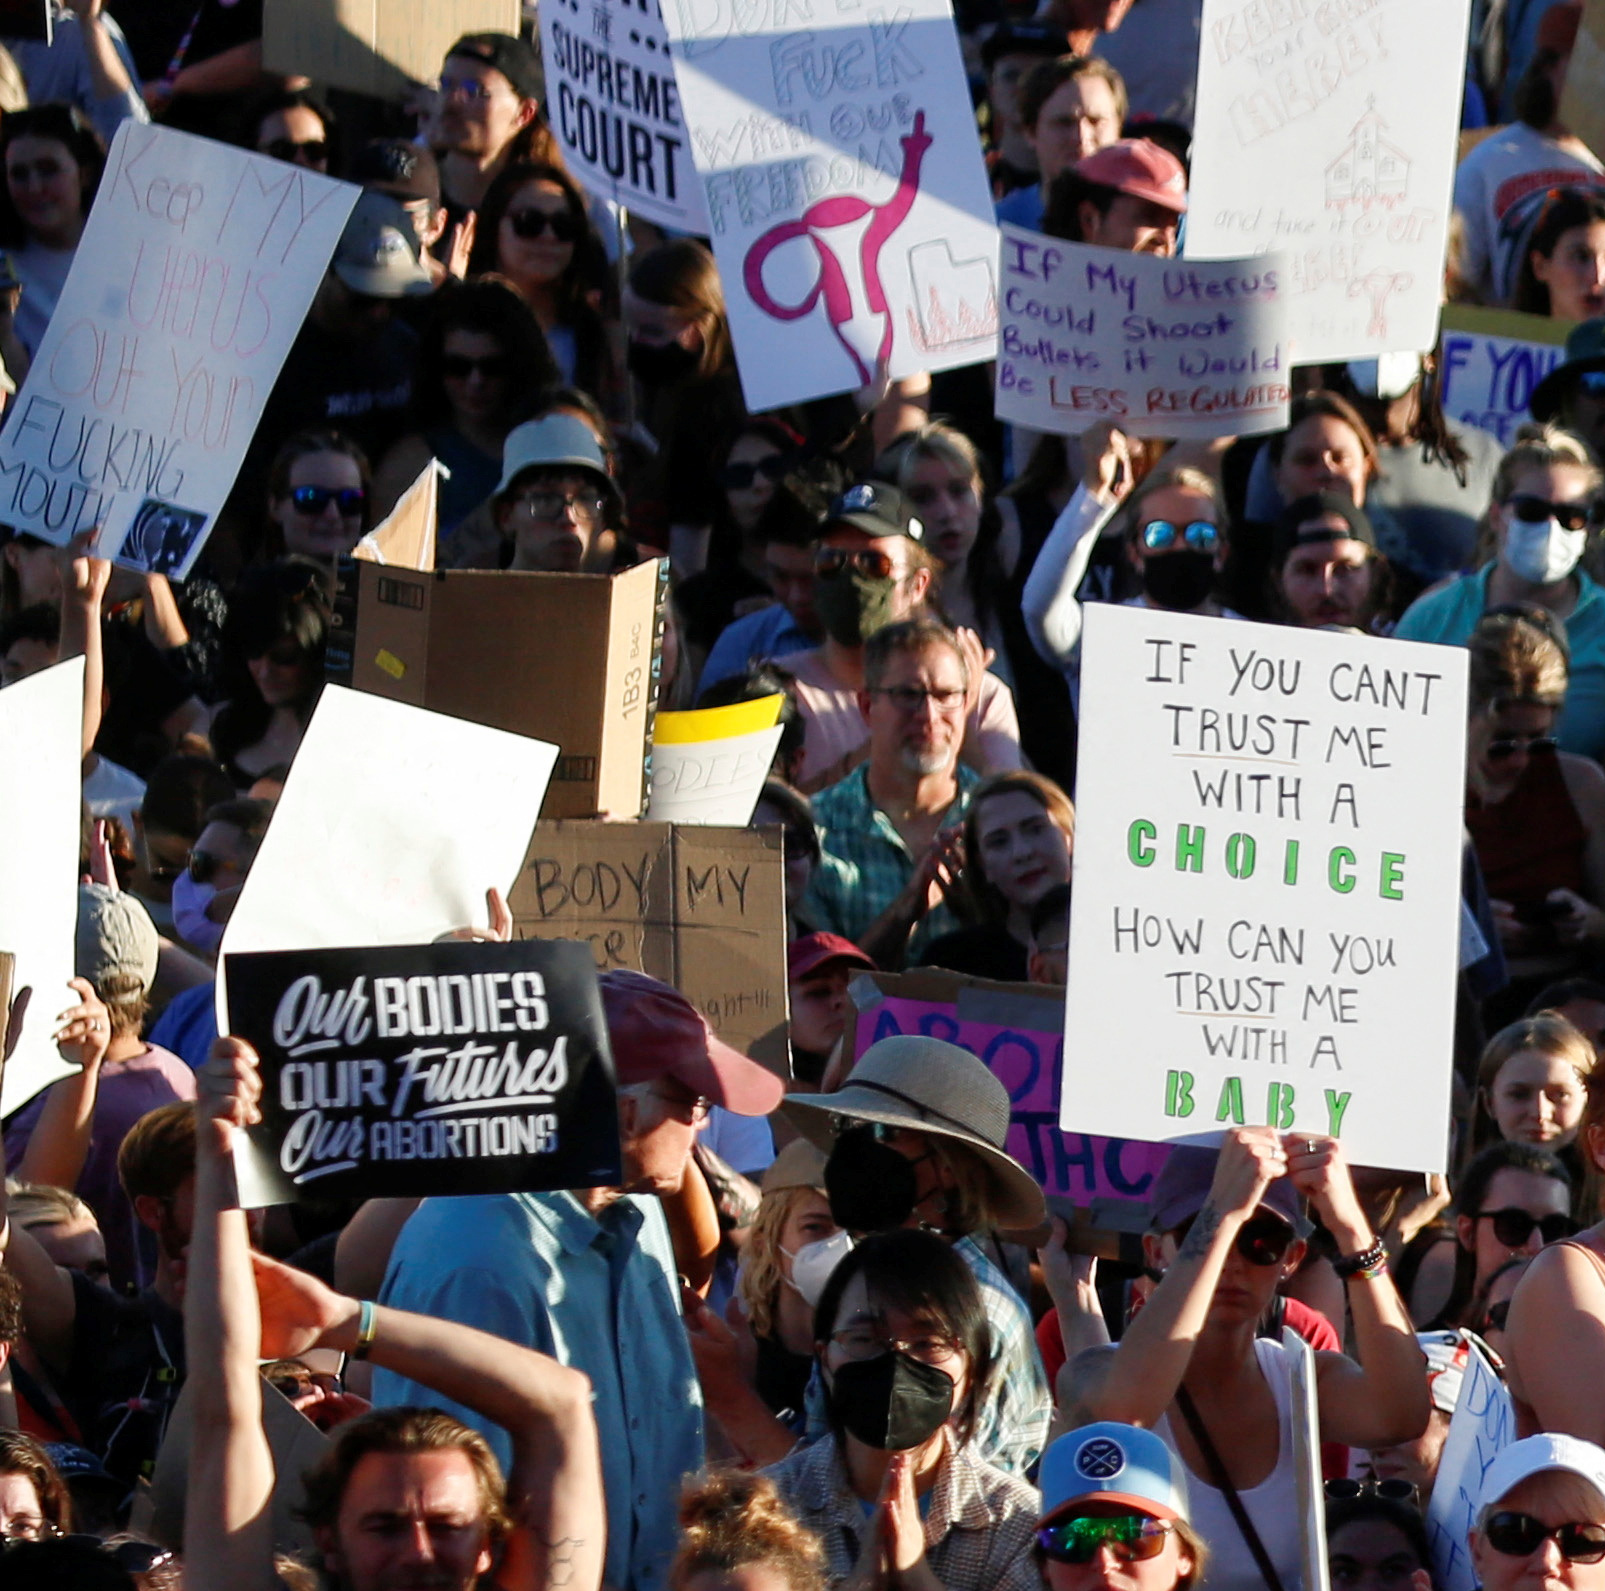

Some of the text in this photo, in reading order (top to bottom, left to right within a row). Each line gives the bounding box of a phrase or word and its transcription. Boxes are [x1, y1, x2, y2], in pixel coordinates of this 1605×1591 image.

[552, 21, 682, 127] SUPREME
[559, 82, 682, 200] COURT
[1006, 236, 1280, 311] If My Uterus
[1005, 282, 1235, 343] Could Shoot
[1000, 363, 1290, 416] Be LESS REGULATED
[1179, 341, 1284, 378] Would
[12, 395, 185, 498] FUCKING
[1145, 639, 1442, 716] IF YOU CANT
[1163, 704, 1392, 770] TRUST ME
[1192, 770, 1359, 828] WITH A
[529, 855, 751, 918] BODY MY
[1127, 818, 1407, 901] CHOICE
[1114, 907, 1397, 975] HOW CAN YOU
[273, 972, 548, 1048] Our BODIES
[1165, 971, 1359, 1024] TRUST ME
[280, 1037, 568, 1119] OUR Futures
[1201, 1024, 1343, 1071] WITH A
[1164, 1069, 1352, 1139] BABY
[280, 1111, 558, 1176] Our ABORTIONS
